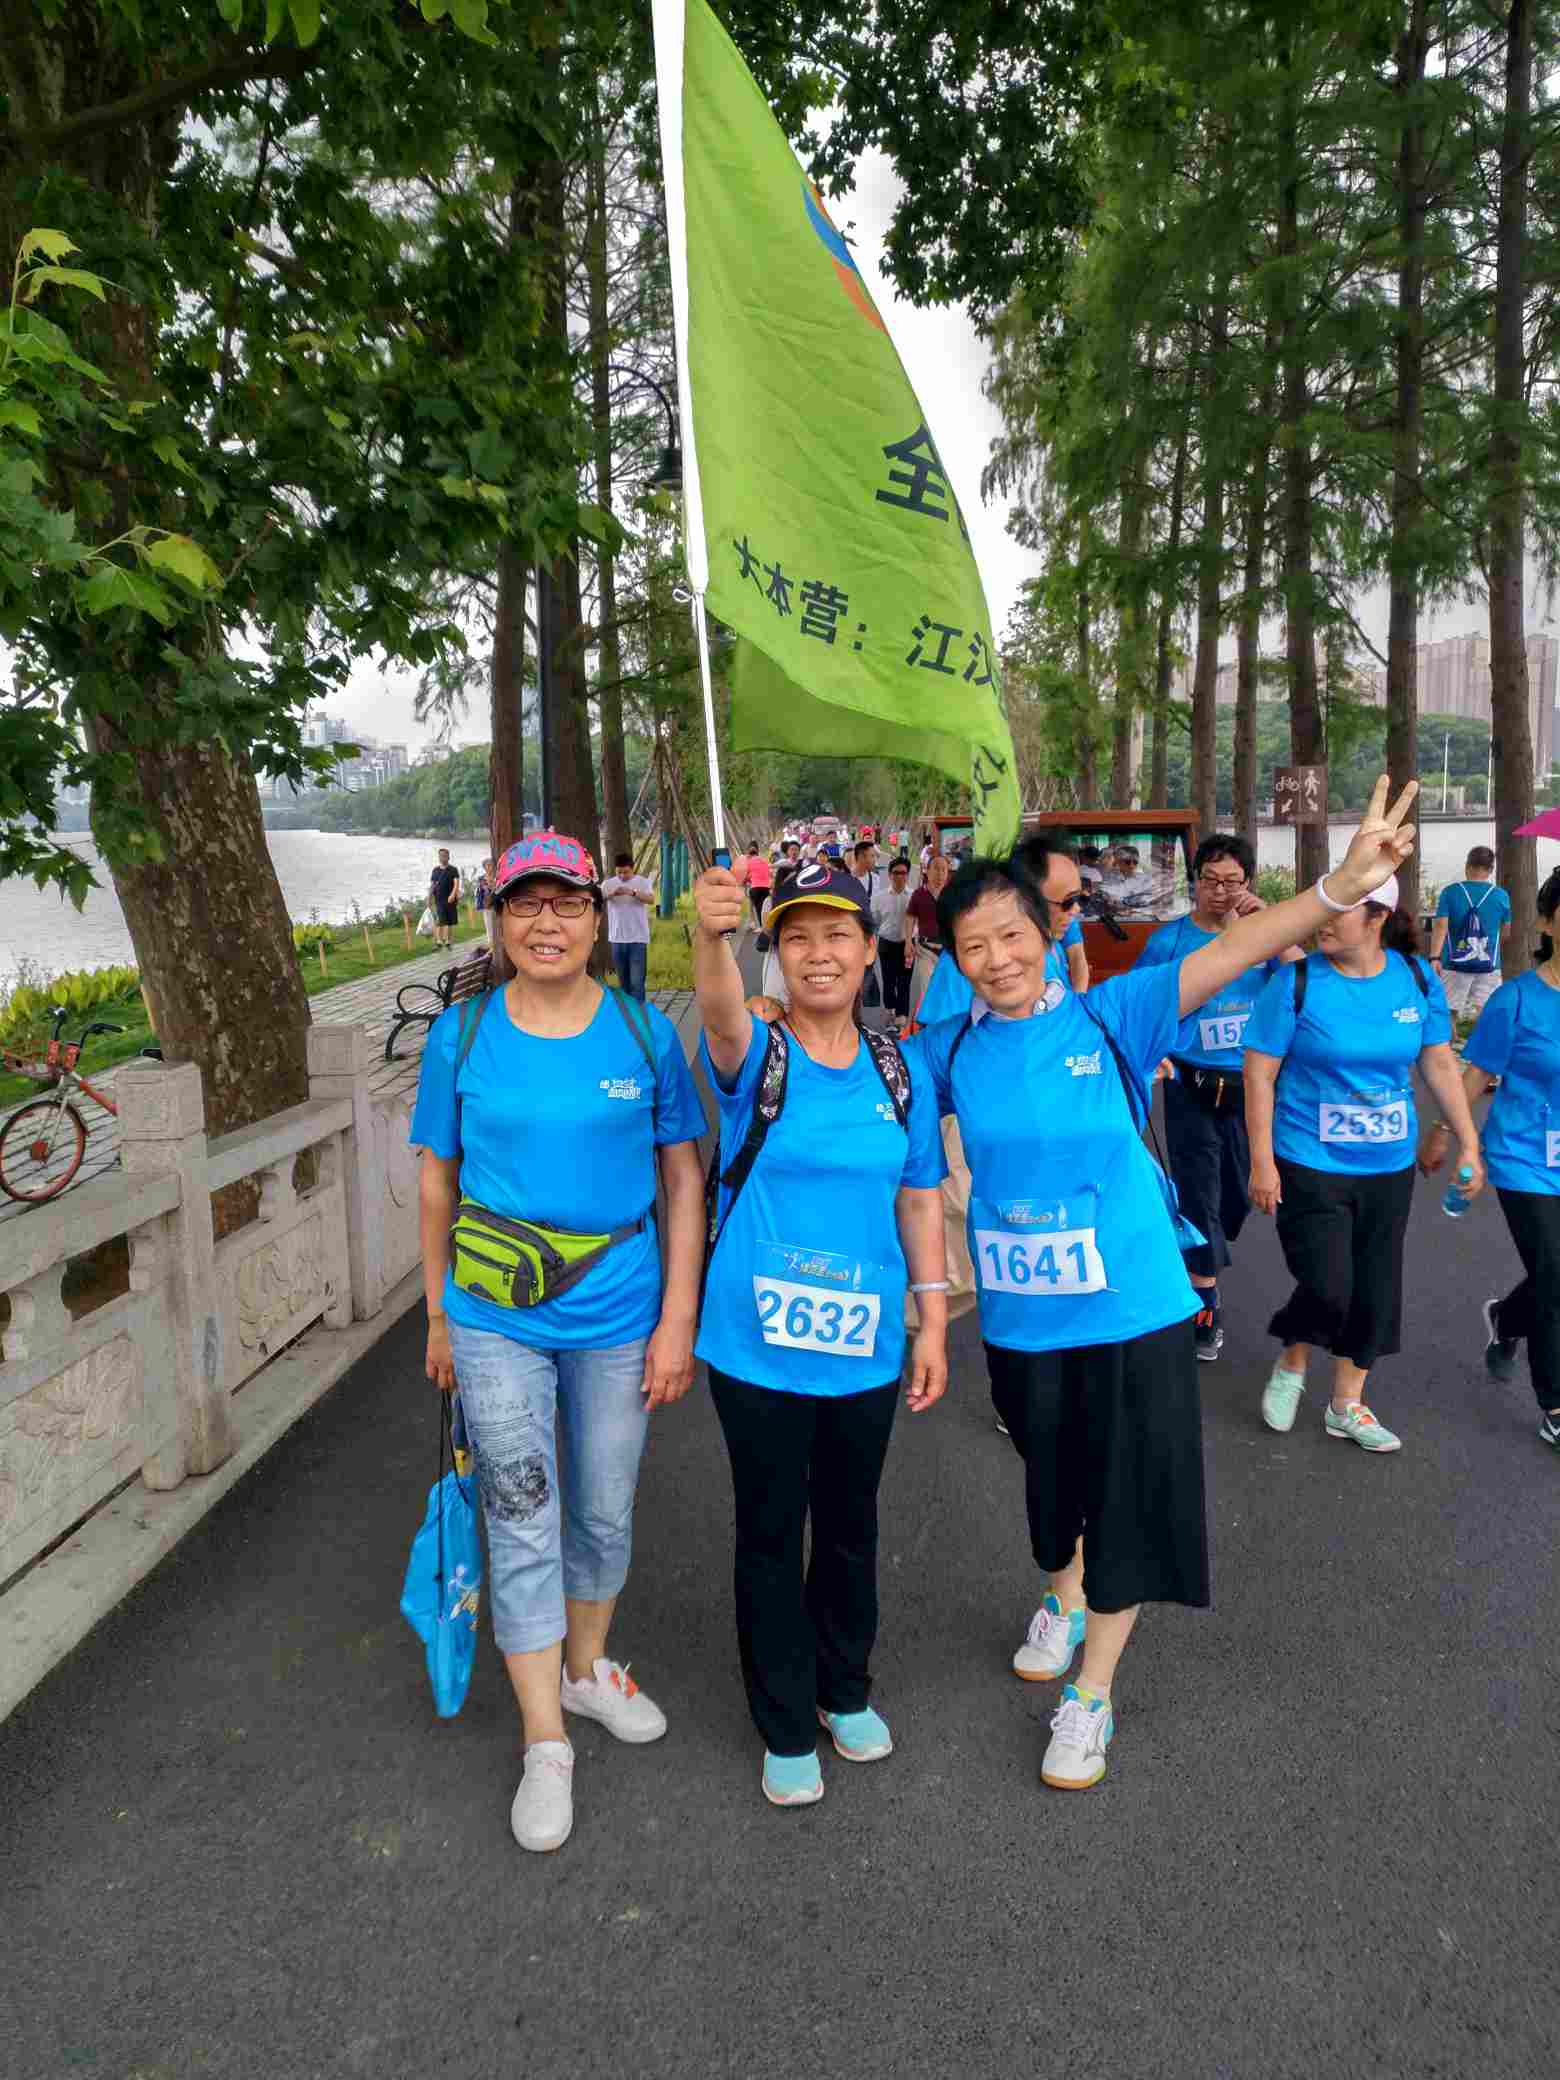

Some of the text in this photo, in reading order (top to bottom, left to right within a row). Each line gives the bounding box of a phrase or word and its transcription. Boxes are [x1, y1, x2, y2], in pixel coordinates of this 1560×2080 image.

[1328, 1110, 1402, 1137] 2539
[985, 1241, 1088, 1285] 1641
[758, 1290, 870, 1344] 2632
